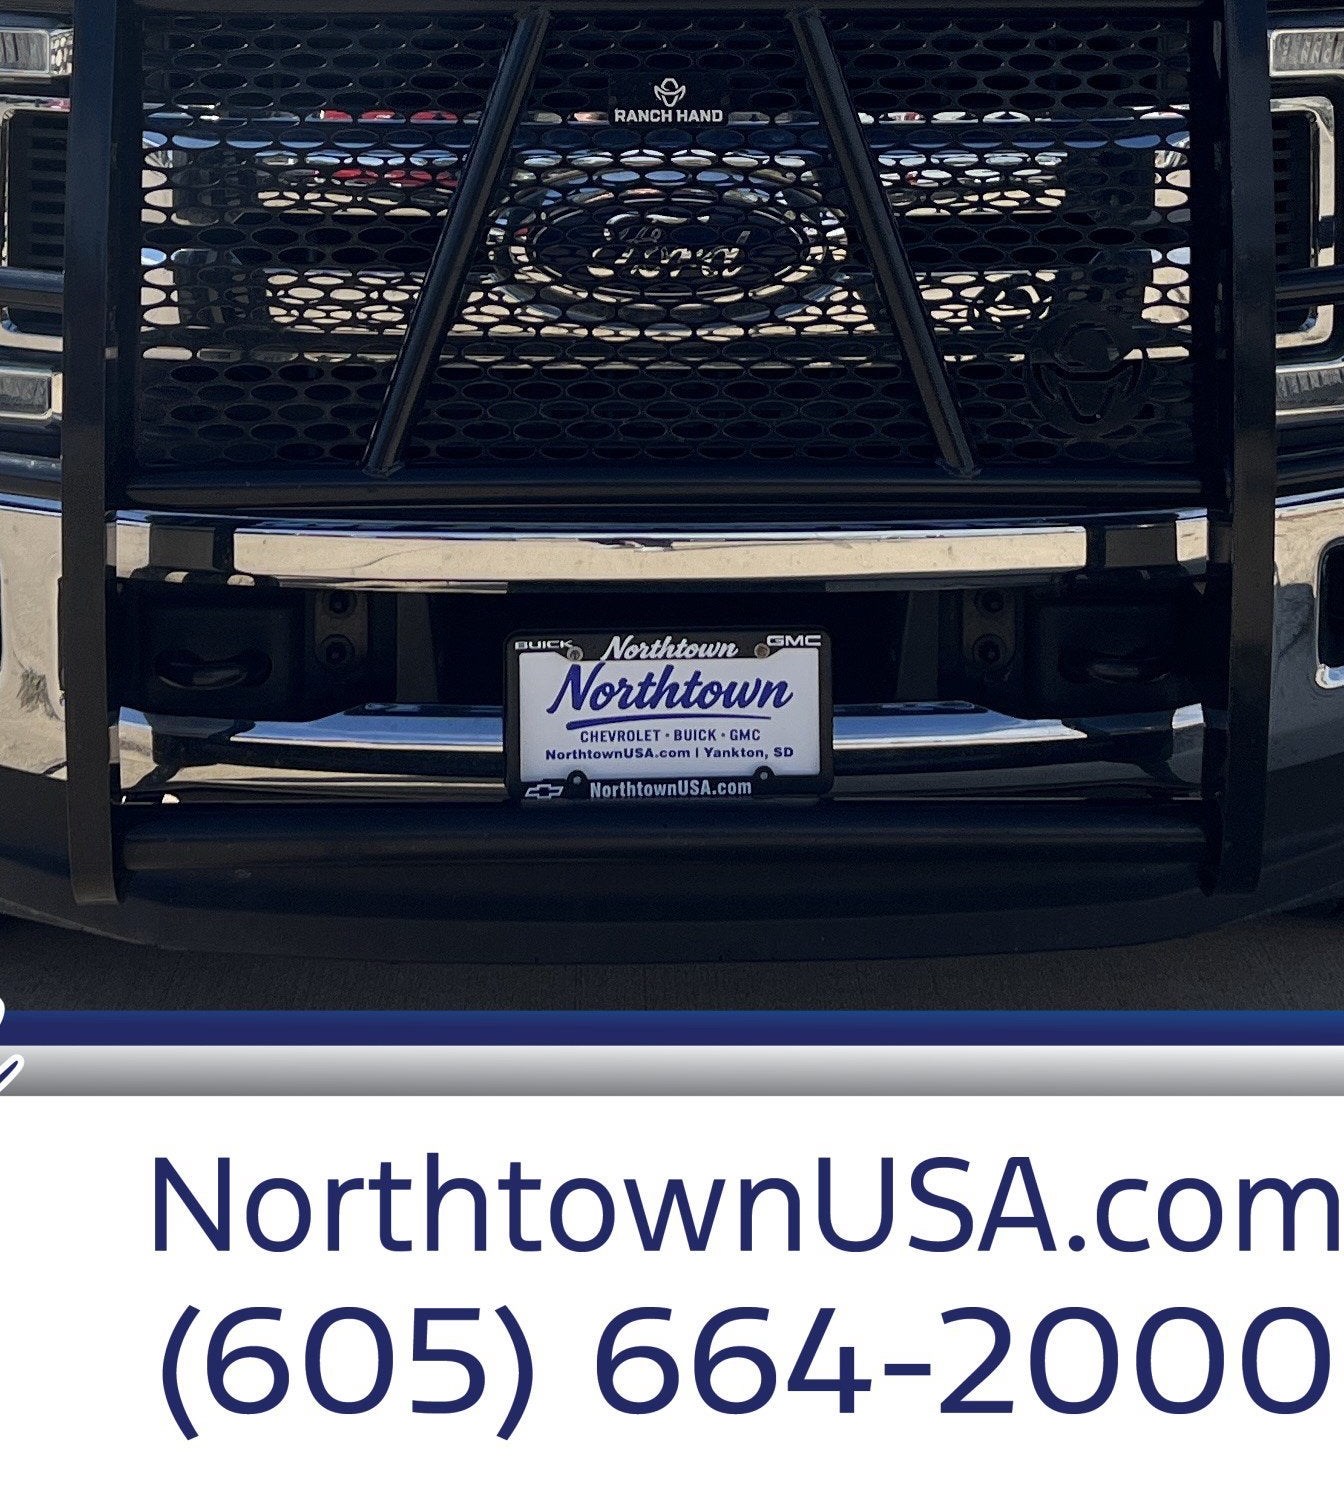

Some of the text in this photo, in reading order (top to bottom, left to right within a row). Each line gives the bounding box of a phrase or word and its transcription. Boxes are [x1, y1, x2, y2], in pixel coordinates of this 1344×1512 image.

[614, 108, 724, 123] RANCH HAND
[514, 639, 574, 651] BUICK
[600, 634, 739, 662] Northtown
[766, 634, 822, 647] GMC
[546, 660, 794, 714] Northtown
[580, 728, 761, 743] CHEVROLET BUICK GMC
[545, 746, 794, 761] NorthtownUSA.com Yankton, SD
[589, 779, 752, 799] NorthtownUSA.com
